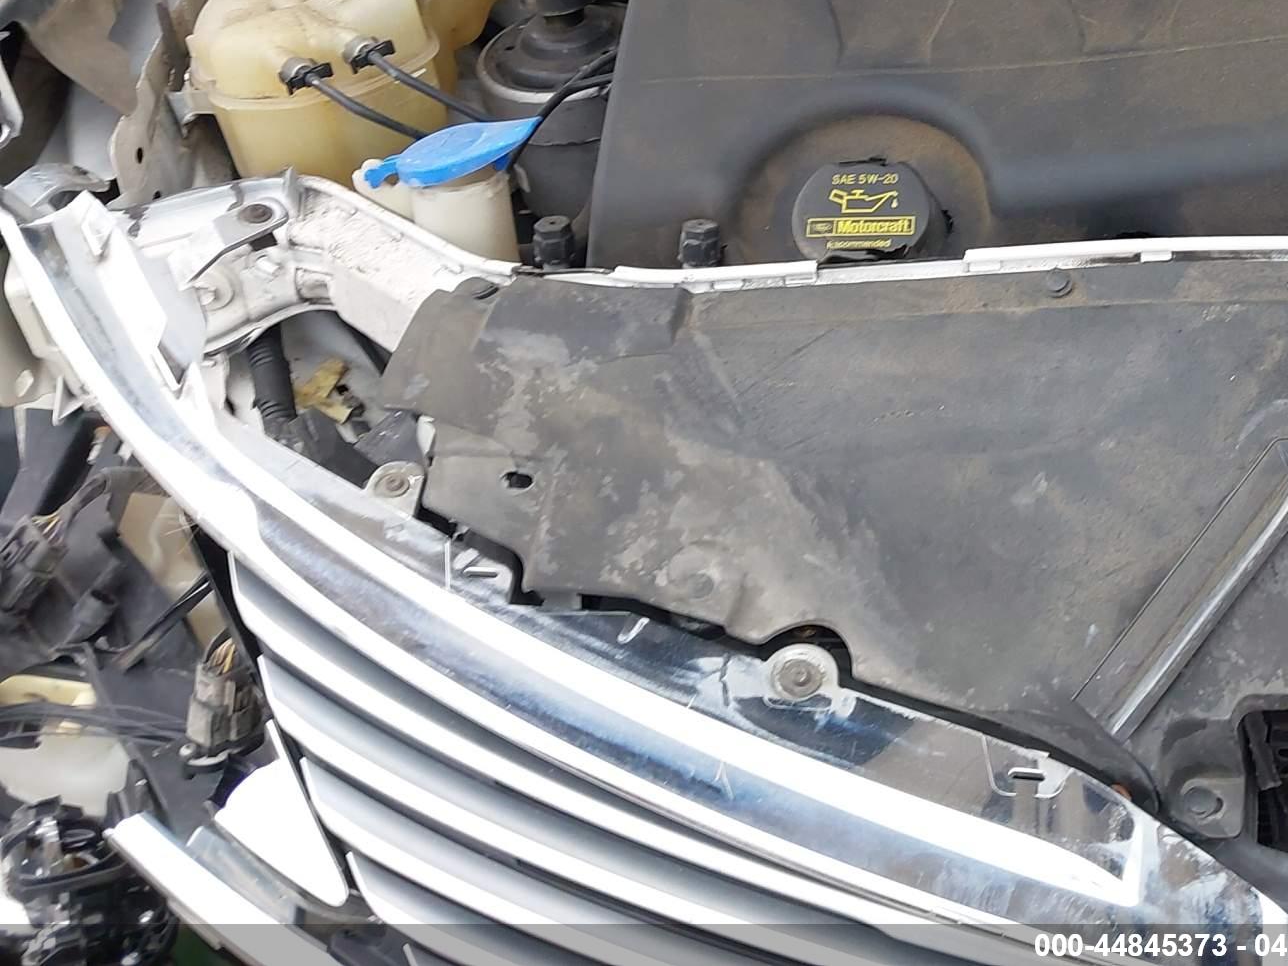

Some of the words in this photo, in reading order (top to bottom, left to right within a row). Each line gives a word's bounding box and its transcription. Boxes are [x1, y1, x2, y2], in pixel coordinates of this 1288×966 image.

[831, 173, 855, 185] SAE
[858, 172, 899, 185] 5W-20
[837, 218, 912, 234] Motorcraft
